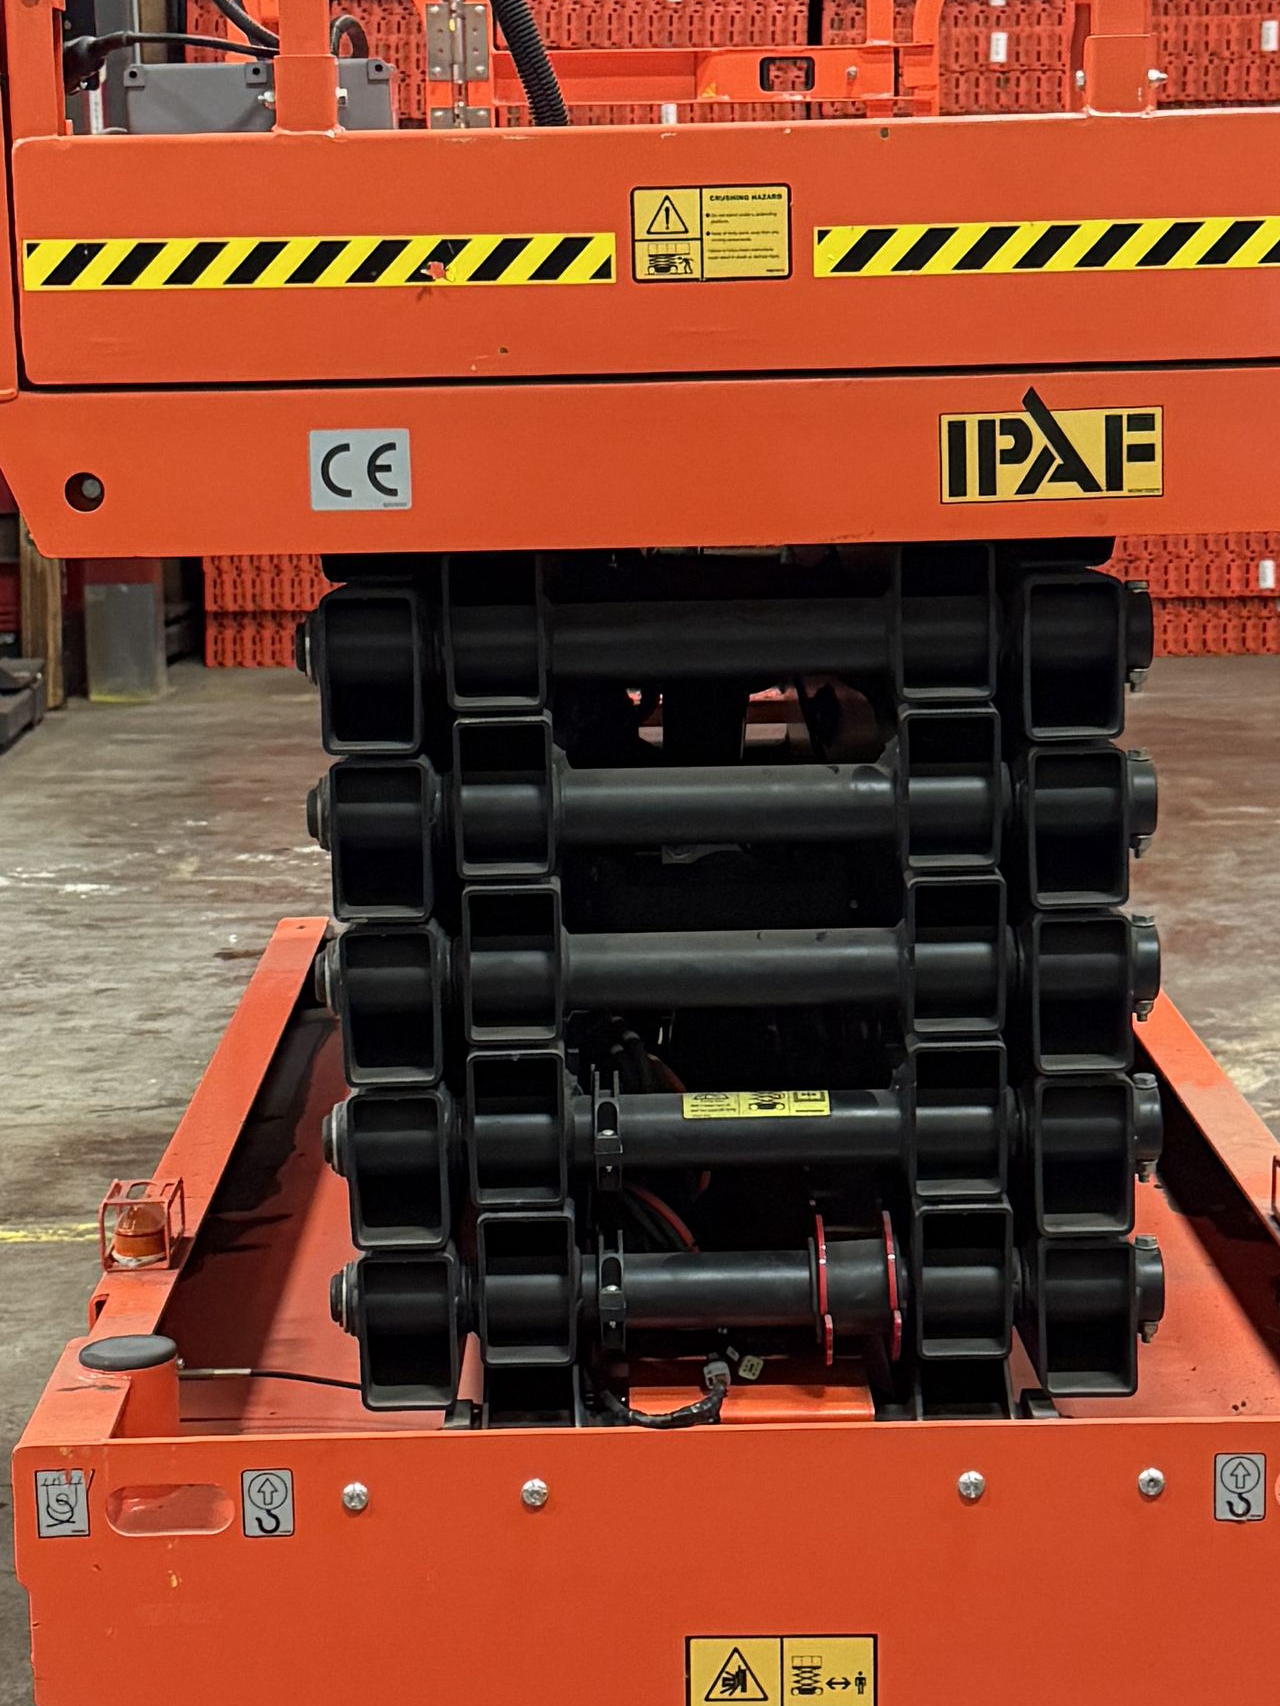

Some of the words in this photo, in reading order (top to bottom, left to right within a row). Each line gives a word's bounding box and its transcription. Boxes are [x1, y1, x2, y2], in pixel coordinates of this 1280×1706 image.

[709, 194, 750, 202] CRUSHING
[751, 193, 783, 201] HAZARD
[321, 442, 399, 498] CE
[947, 386, 1156, 498] IPAF
